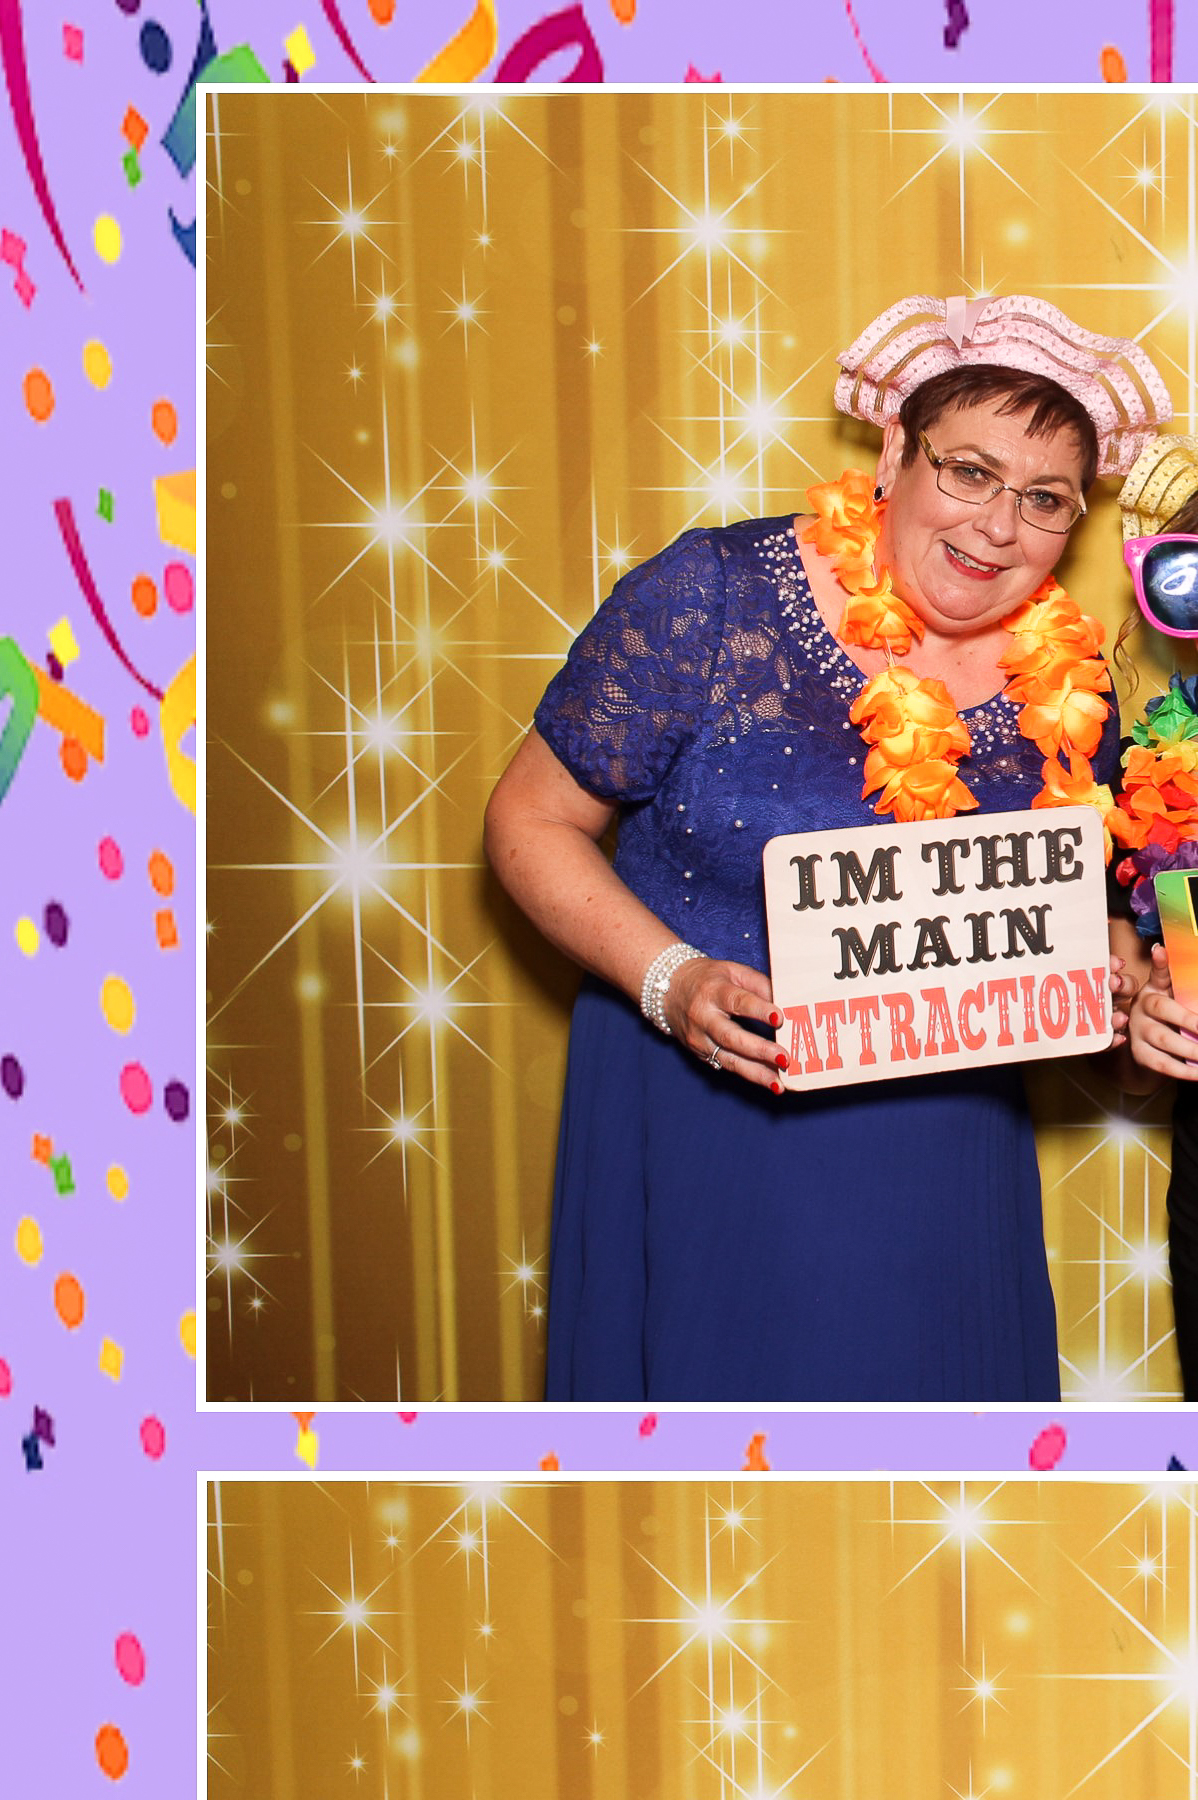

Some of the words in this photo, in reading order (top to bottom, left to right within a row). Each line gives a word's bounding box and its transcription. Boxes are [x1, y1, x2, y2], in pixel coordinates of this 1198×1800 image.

[790, 845, 904, 911] IM
[921, 826, 1084, 896] THE
[832, 903, 1054, 980] MAIN
[783, 966, 1107, 1077] ATTRACTION
